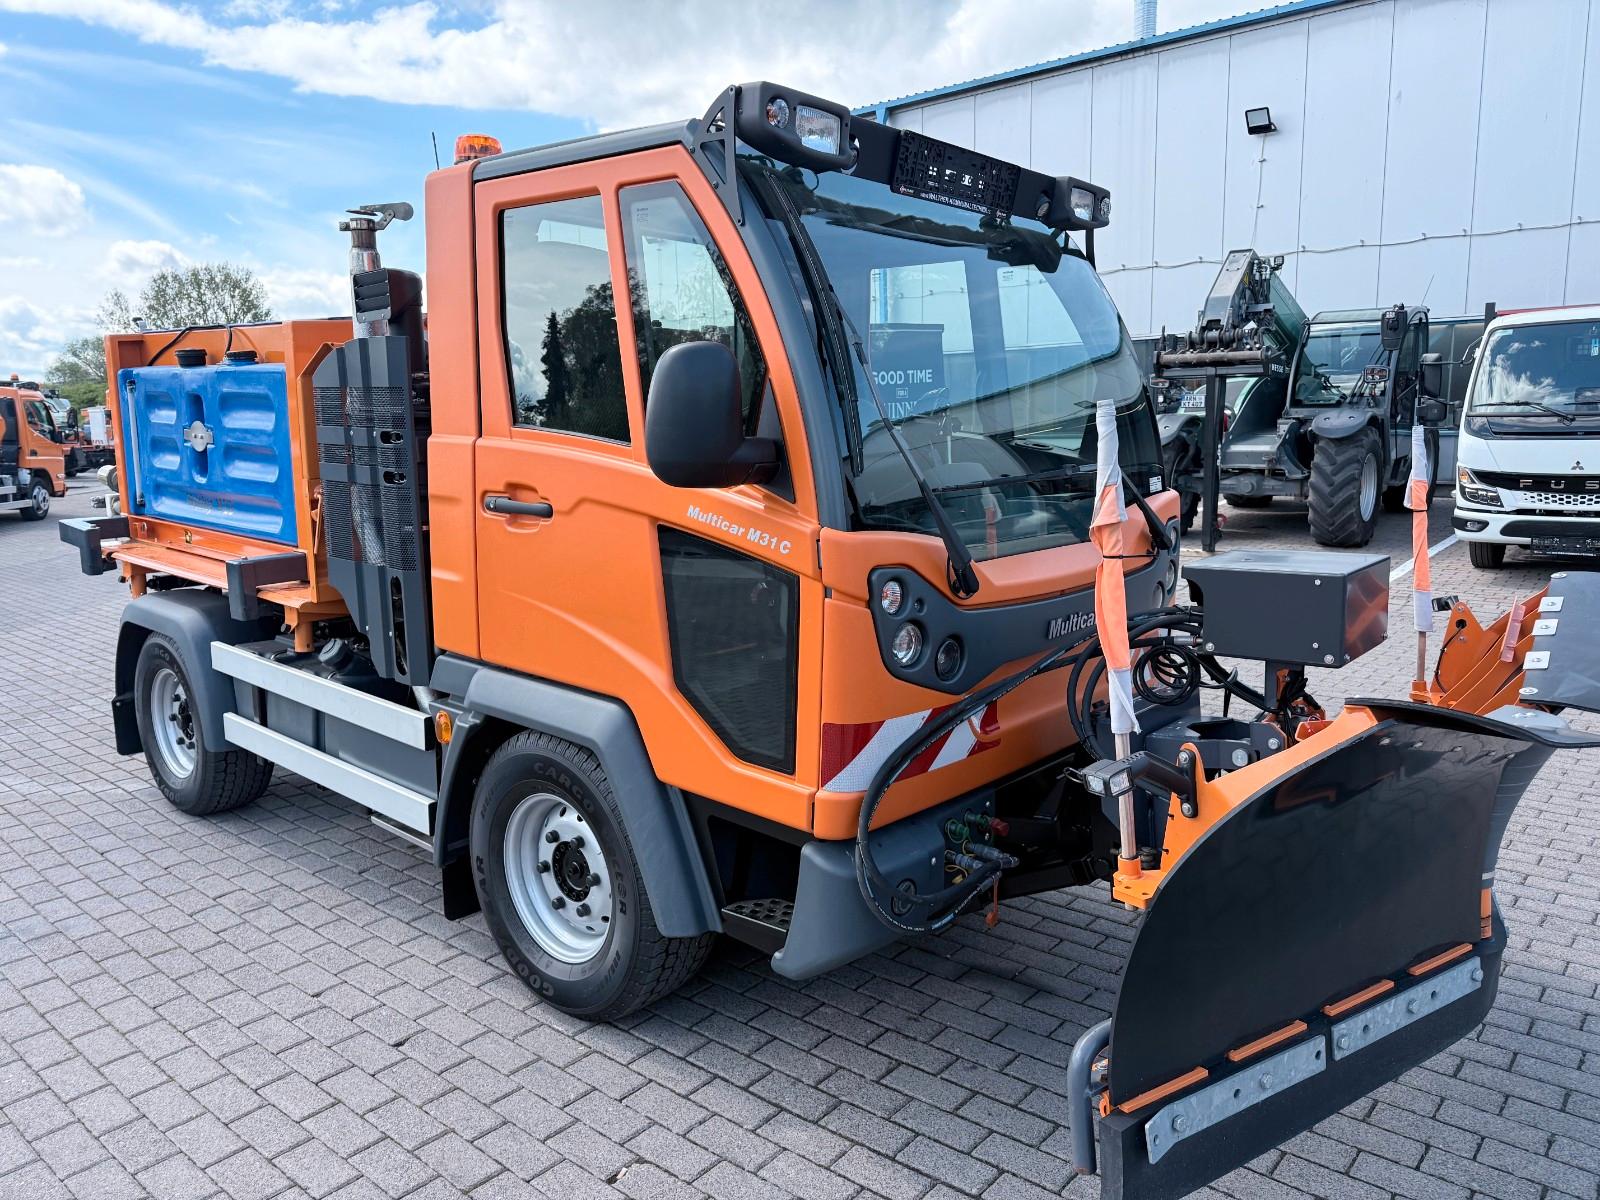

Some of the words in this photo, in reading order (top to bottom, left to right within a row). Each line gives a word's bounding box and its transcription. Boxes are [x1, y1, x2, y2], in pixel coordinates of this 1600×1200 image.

[907, 369, 933, 384] TIME
[687, 504, 746, 537] Multicar
[1048, 611, 1097, 640] Multica
[533, 762, 595, 814] CARGO
